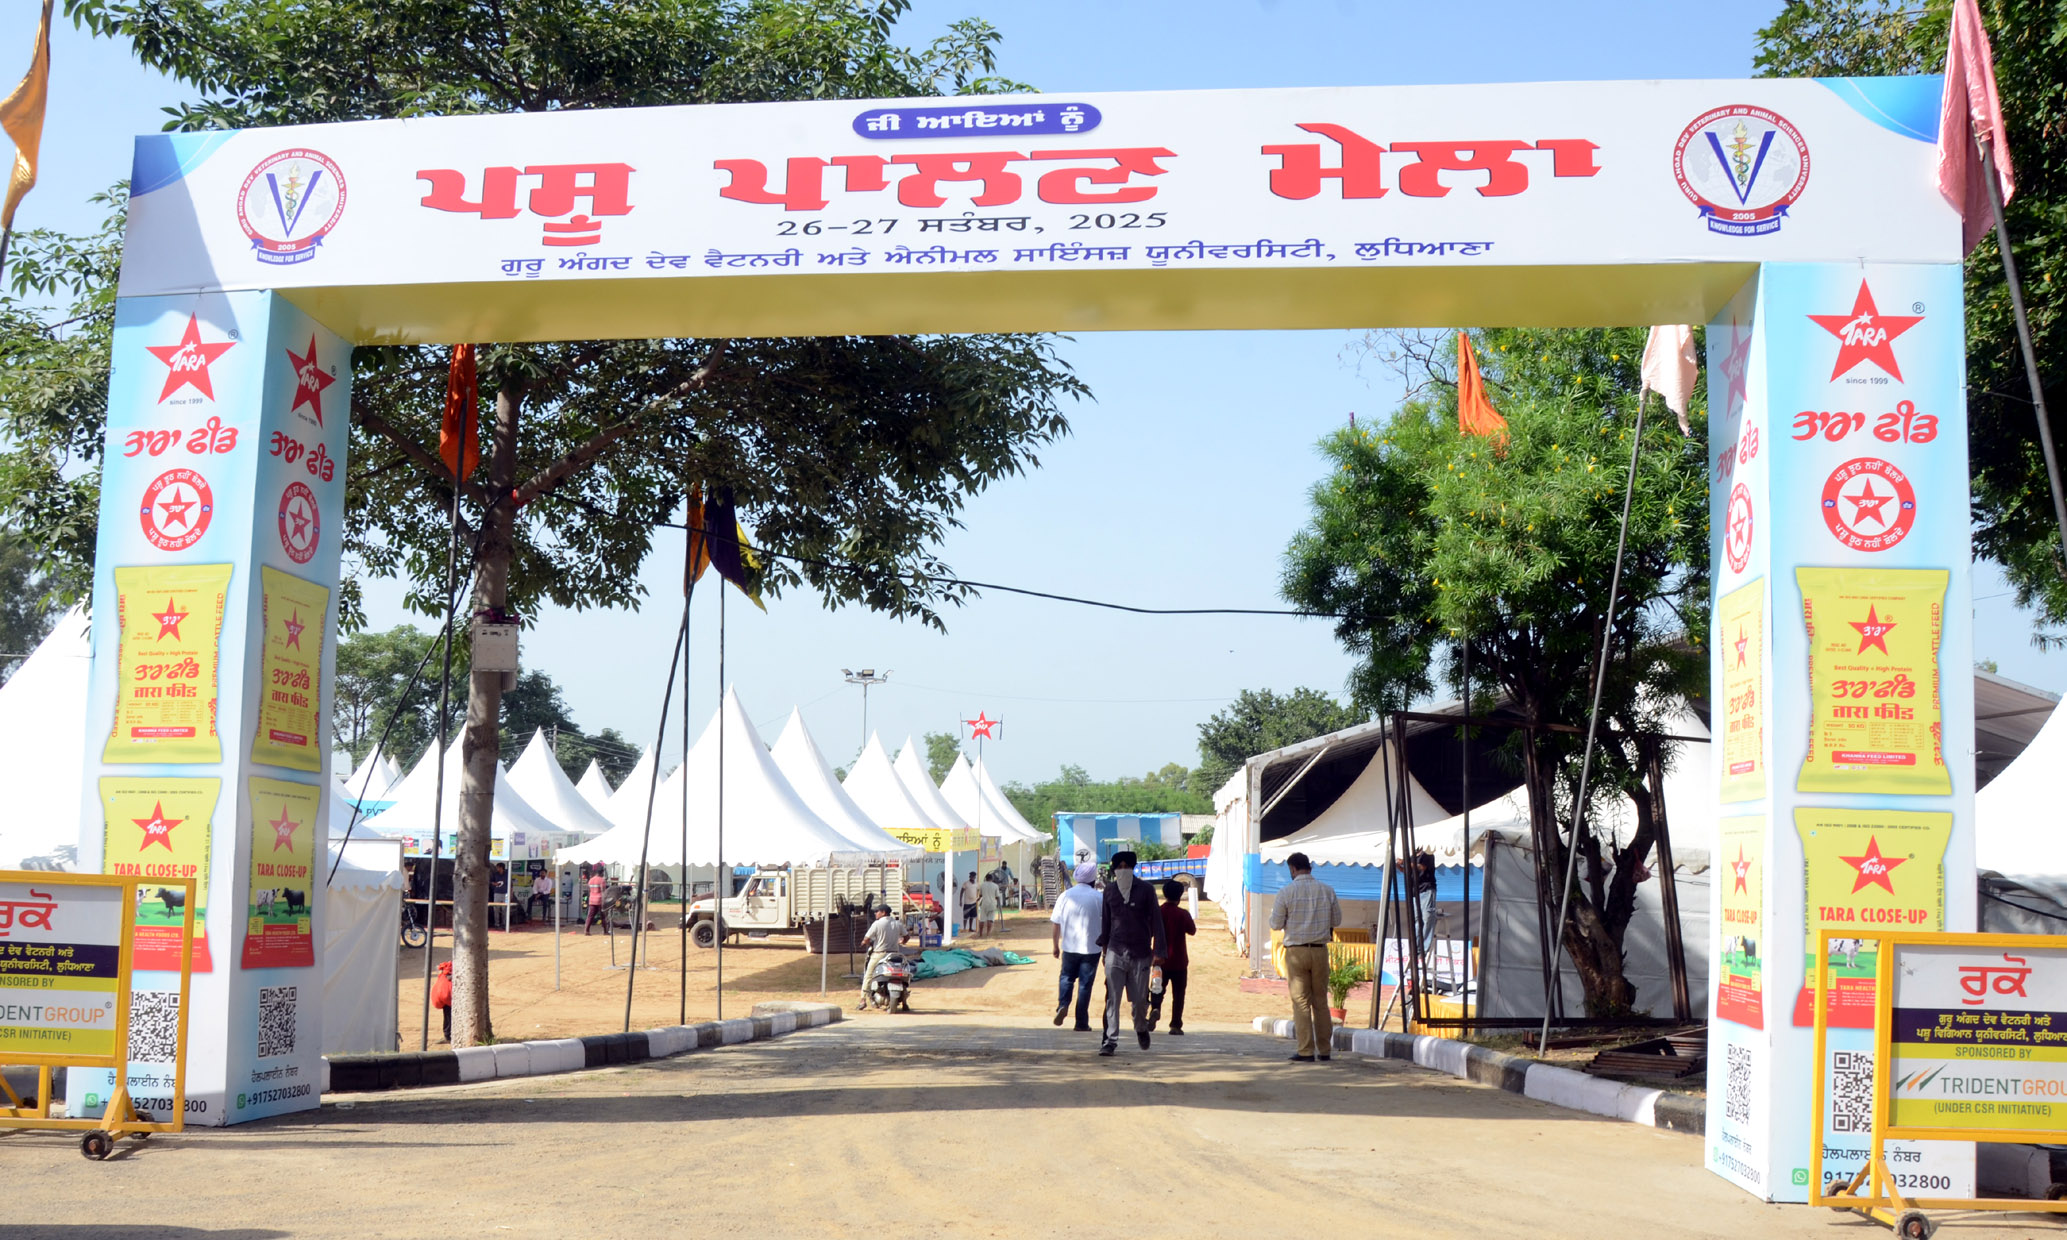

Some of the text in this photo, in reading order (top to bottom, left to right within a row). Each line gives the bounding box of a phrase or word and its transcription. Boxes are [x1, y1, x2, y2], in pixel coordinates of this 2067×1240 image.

[866, 106, 1084, 131] ਜੀ ਆਇਆਂ ਨੂੰ
[1733, 107, 1748, 115] AND
[1750, 108, 1777, 123] ANIMAL
[1689, 108, 1731, 133] VETERINARY
[1678, 132, 1690, 149] DEV
[1777, 119, 1806, 153] SCIENCES
[416, 123, 1602, 247] ਪਸ਼ੂ ਪਾਲਣ ਮੇਲਾ
[1787, 154, 1810, 202] UNIVERSITY
[1681, 181, 1699, 202] GURU
[918, 212, 1044, 234] ਸਤੰਬਰ,
[1068, 212, 1168, 230] 2025
[1732, 212, 1756, 221] 2005
[1710, 220, 1779, 234] KNOWLEDGE FOR SERVICE
[277, 243, 297, 251] 2005
[501, 237, 1495, 278] ਗੁਰੂ ਅੰਗਦ ਦੇਵ ਵੈਟਨਰੀ ਅਤੇ ਐਨੀਮਲ ਸਾਇੰਸਜ਼ ਯੂਨੀਵਰਸਿਟੀ, ਲੁਧਿਆਣਾ
[1839, 317, 1887, 347] TARA
[169, 343, 206, 372] TARA
[299, 363, 320, 392] TARA
[1846, 377, 1889, 385] since 1999
[188, 397, 204, 405] 1999
[1791, 399, 1939, 444] ਤਾਰਾ ਫੀਡ
[123, 415, 239, 457] ਤਾਰਾ ਫੀਡ
[1739, 419, 1759, 465] ਫੀਡ
[269, 430, 335, 482] ਤਾਰਾ ਫੀਡ
[1931, 602, 1940, 627] FEED
[1875, 665, 1890, 673] High
[134, 682, 198, 699] तारा फीड
[1832, 702, 1914, 720] तारा फीड
[146, 819, 167, 835] TARA
[114, 862, 198, 878] TARA CLOSE-UP
[257, 862, 308, 878] TARA CLOSE-UP
[1860, 859, 1886, 875] TARA
[1819, 906, 1928, 924] TARA CLOSE-UP
[8, 944, 22, 956] ਦੇਵ
[25, 943, 55, 957] ਵੈਟਨਰੀ
[58, 946, 74, 957] ਅਤੇ
[42, 977, 55, 987] BY
[1959, 952, 2032, 1005] ਰੁਕੋ
[1939, 1011, 2052, 1028] ਗੁਰੂ ਅੰਗਦ ਦੇਵ ਵੈਟਨਰੀ ਅਤੇ
[19, 1029, 72, 1043] INITIATIVE)
[1934, 1026, 1973, 1040] ਵਿਗਿਆਨ
[1975, 1027, 2030, 1043] ਯੂਨੀਵਰਸਿਟੀ,
[1955, 1046, 2032, 1059] SPONSORED BY
[247, 1084, 311, 1106] +917527032800
[1934, 1102, 2052, 1117] (UNDER CSR INITIATIVE)
[1893, 1146, 1922, 1163] ਨੰਬਰ
